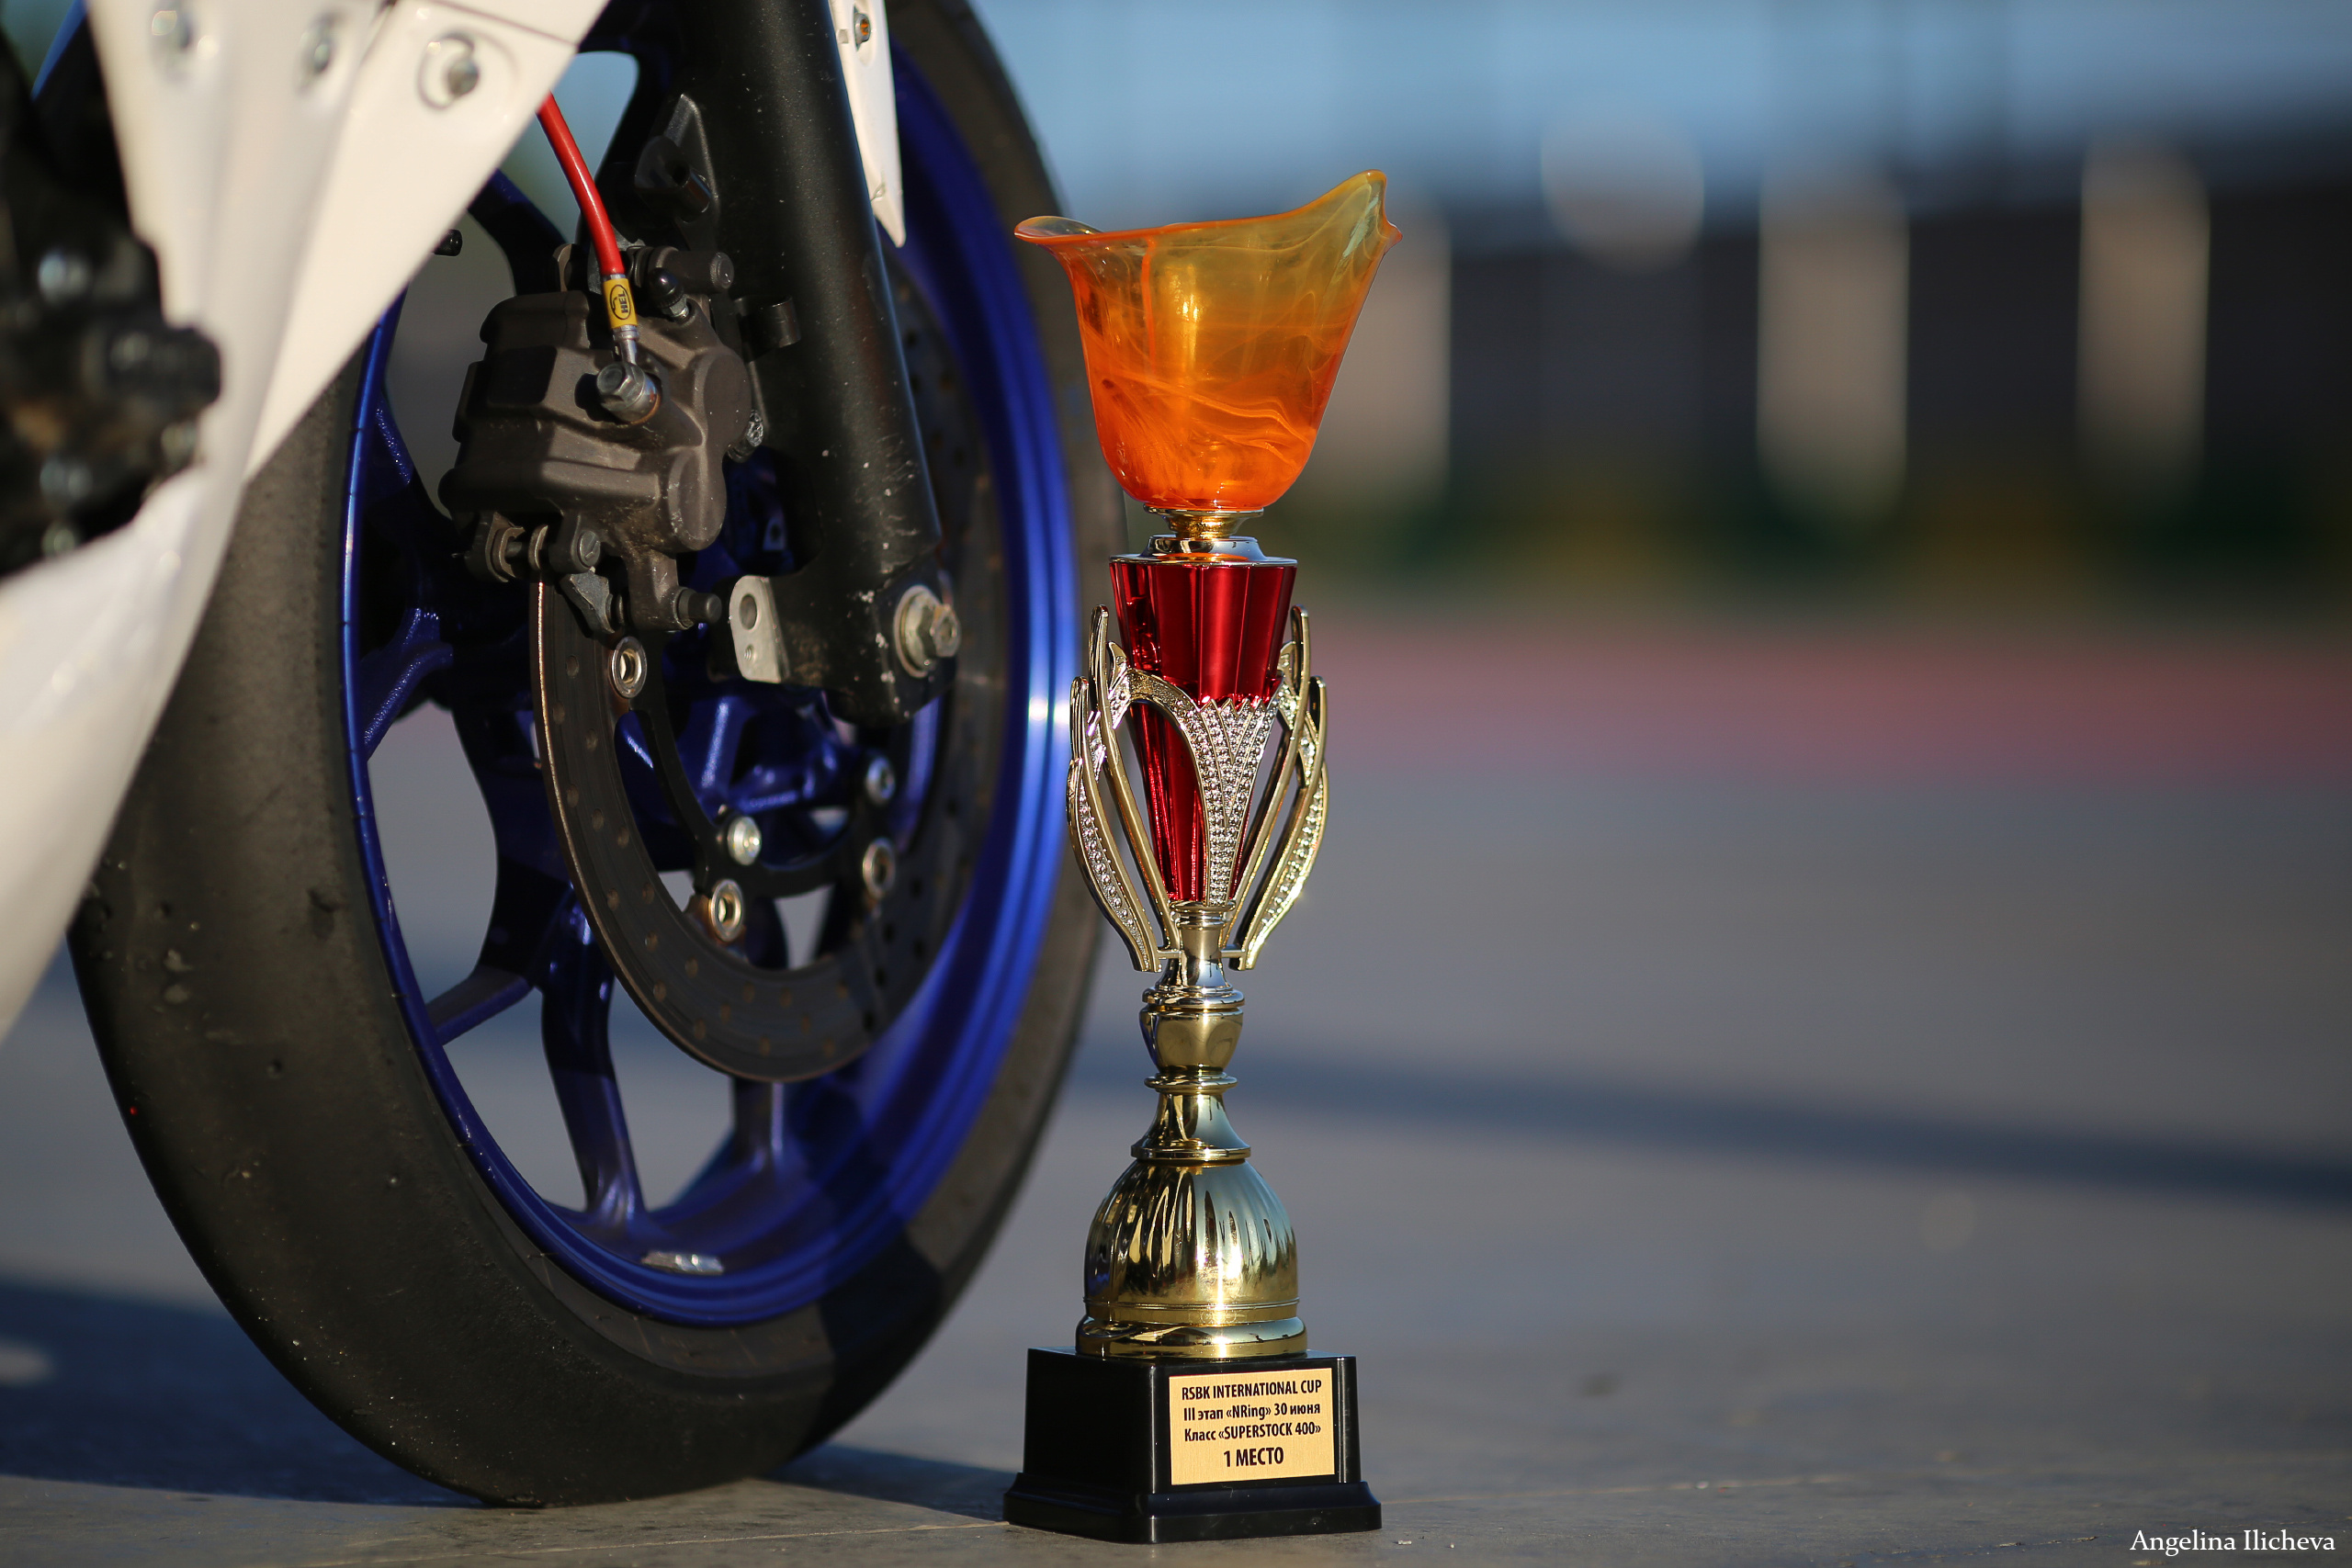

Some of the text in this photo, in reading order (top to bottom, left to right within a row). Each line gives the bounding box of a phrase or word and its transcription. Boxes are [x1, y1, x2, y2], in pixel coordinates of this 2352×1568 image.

[618, 290, 628, 313] HEL
[1182, 1379, 1322, 1401] RSBK INTERNATIONAL CUP
[1183, 1407, 1195, 1421] III
[1197, 1408, 1224, 1420] этап
[1273, 1403, 1287, 1416] 30
[1289, 1404, 1321, 1415] июня
[1184, 1428, 1216, 1442] Класс
[1223, 1447, 1284, 1467] 1 МЕСТО
